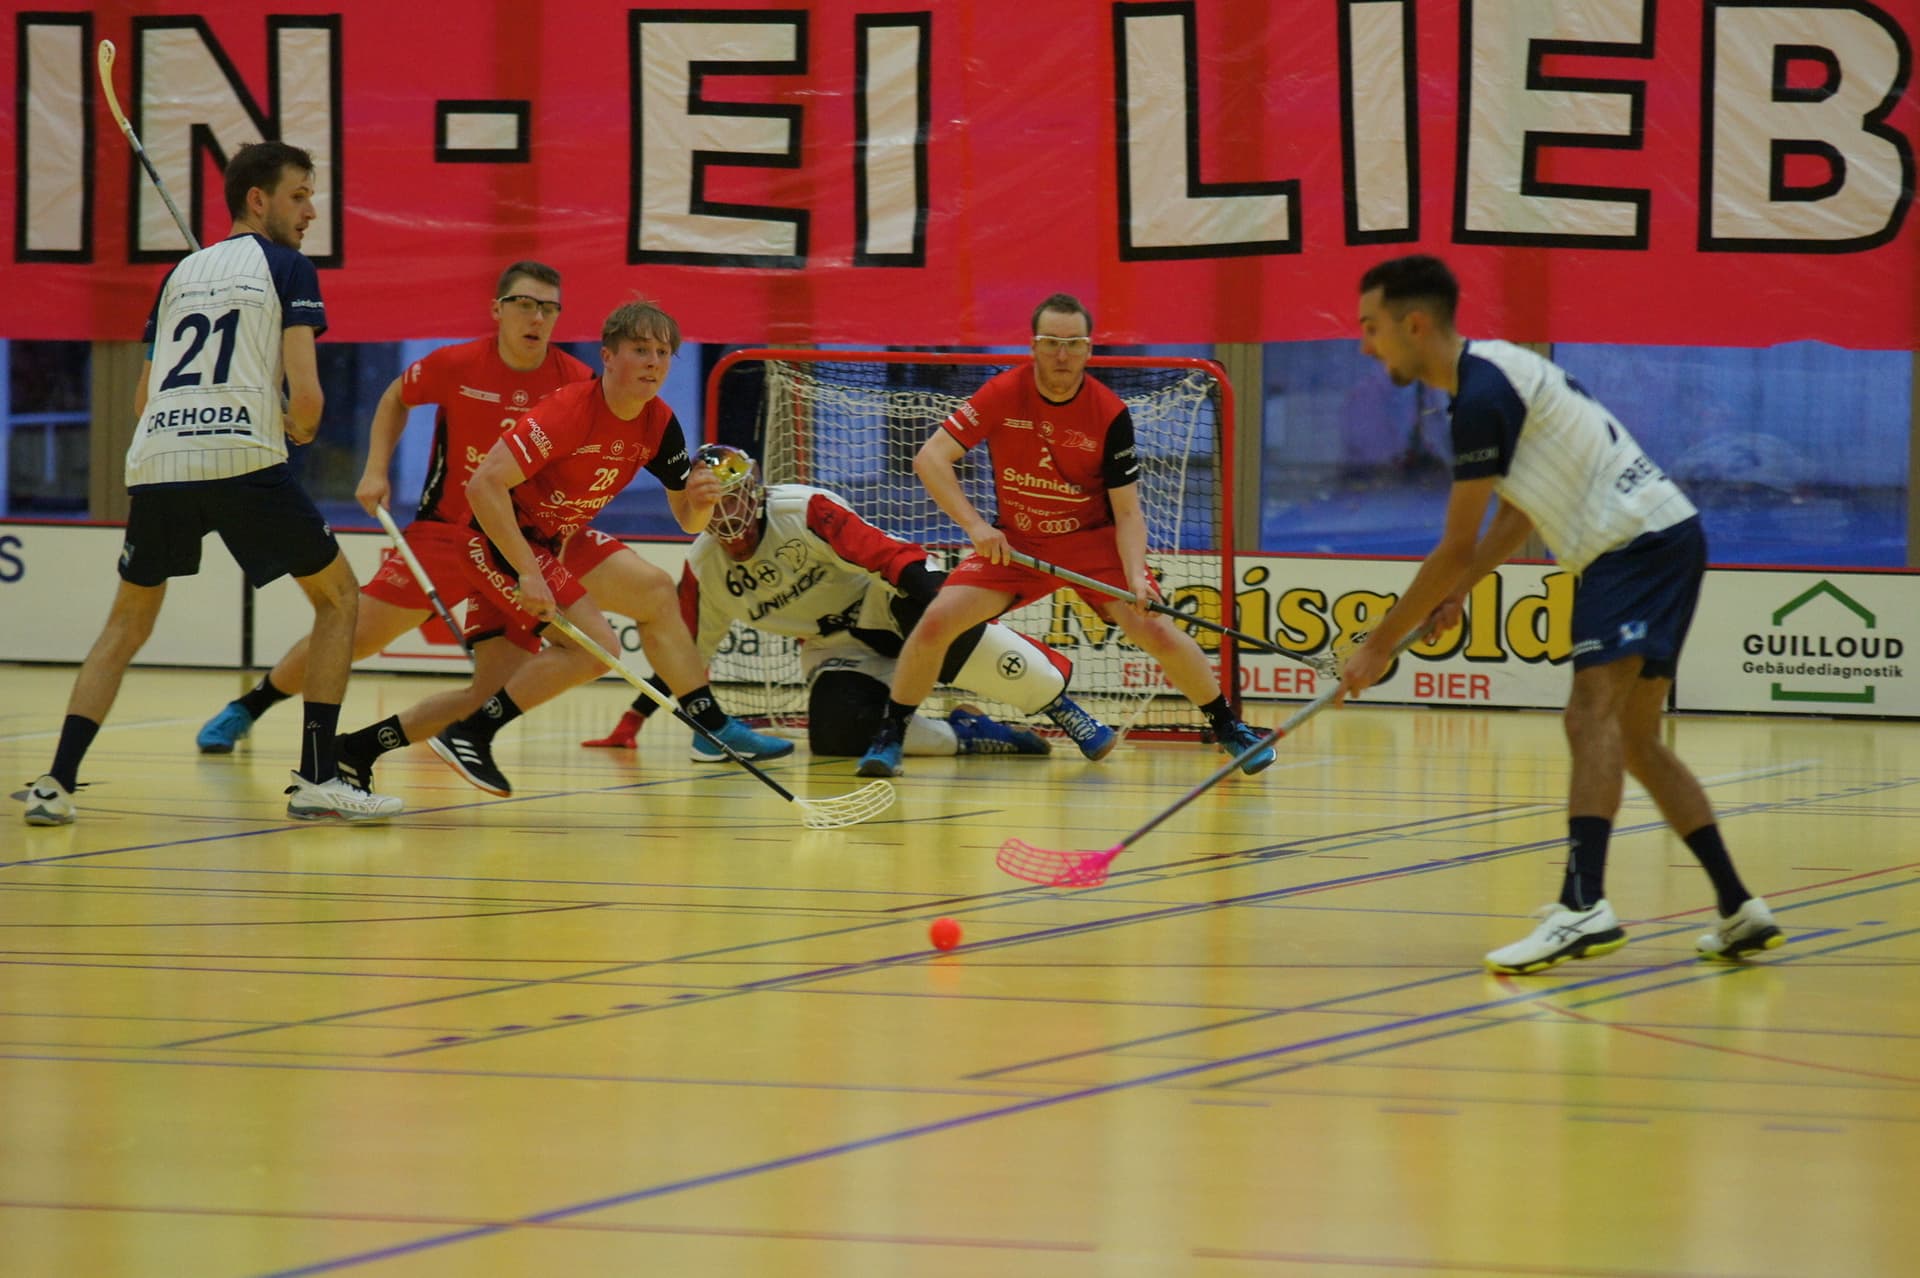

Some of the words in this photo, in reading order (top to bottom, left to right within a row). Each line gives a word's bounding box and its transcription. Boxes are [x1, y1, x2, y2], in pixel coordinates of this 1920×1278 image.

[627, 9, 932, 268] EI
[1113, 0, 1916, 262] LIEB
[159, 309, 240, 392] 21
[588, 467, 620, 492] 28
[1743, 634, 1904, 659] GUILLOUD
[1742, 661, 1903, 684] Gebäudediagnostik
[1414, 672, 1491, 700] BIER
